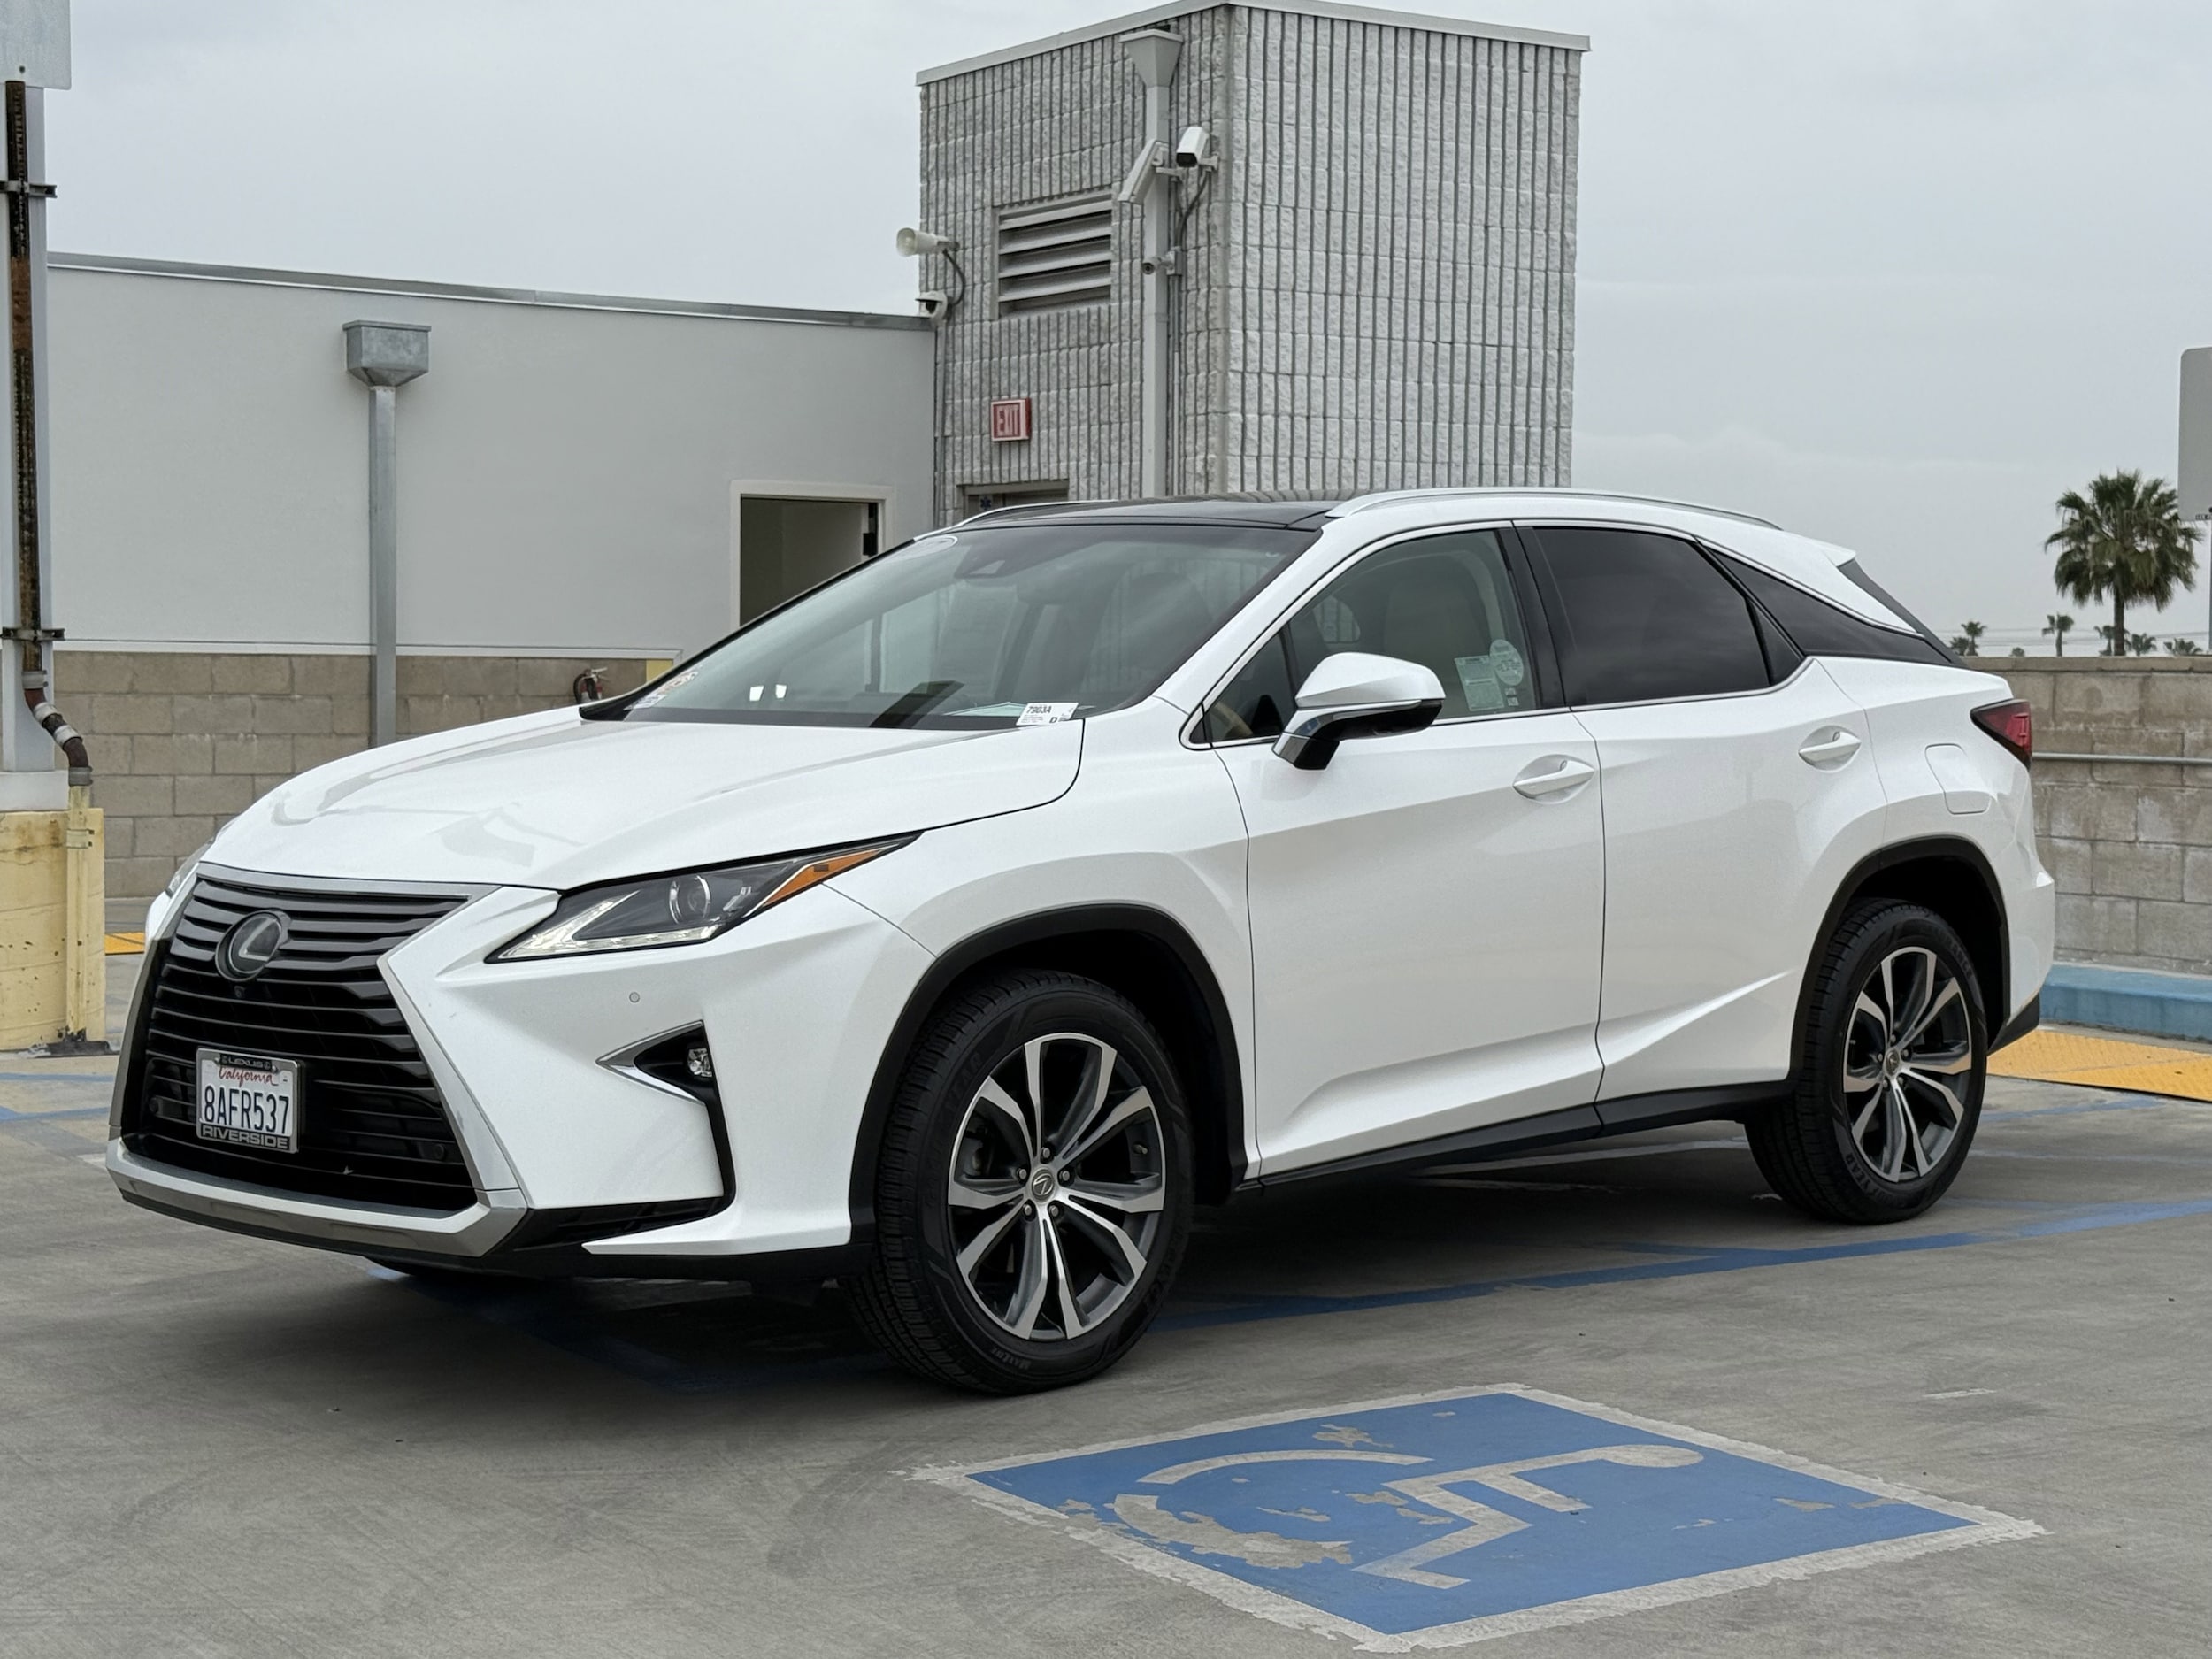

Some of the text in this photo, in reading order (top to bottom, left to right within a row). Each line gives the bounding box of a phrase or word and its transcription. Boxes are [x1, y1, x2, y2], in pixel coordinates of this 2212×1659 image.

[996, 404, 1019, 437] EXIT
[228, 1056, 264, 1069] LEXUS
[219, 1065, 279, 1088] California
[204, 1085, 290, 1134] 8AFR537
[202, 1125, 289, 1149] RIVERSIDE
